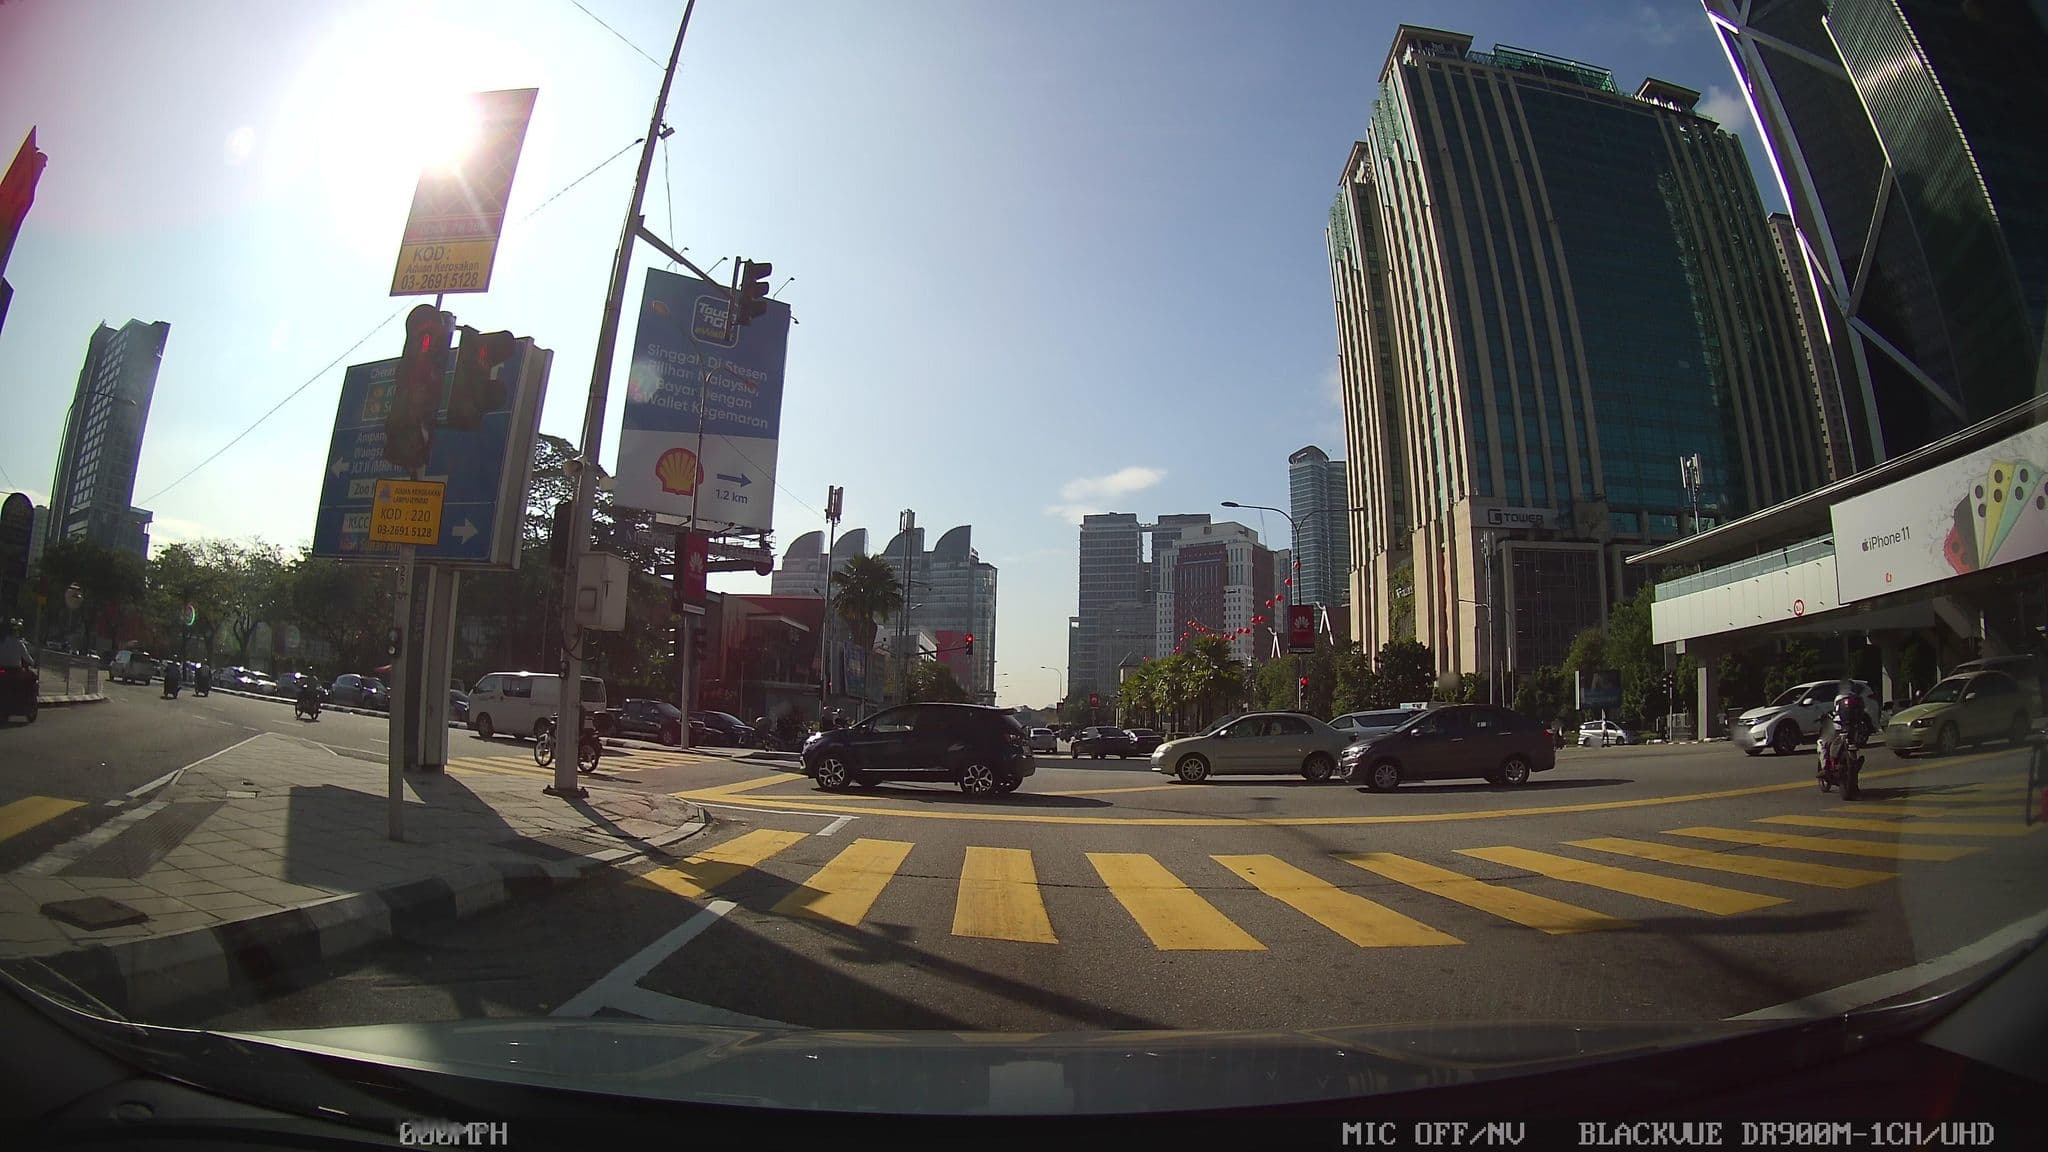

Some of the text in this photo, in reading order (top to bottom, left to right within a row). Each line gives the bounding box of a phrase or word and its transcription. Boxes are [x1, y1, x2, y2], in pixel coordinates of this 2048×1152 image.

[406, 261, 480, 274] Aduan Kerosakan
[707, 356, 722, 369] Di
[726, 361, 768, 381] Stesen
[353, 484, 370, 496] Zoo
[716, 489, 748, 504] 1.2 km
[381, 508, 402, 521] KOD
[411, 509, 432, 522] 220
[348, 516, 370, 529] KLCC
[1869, 526, 1911, 550] iPhone 11
